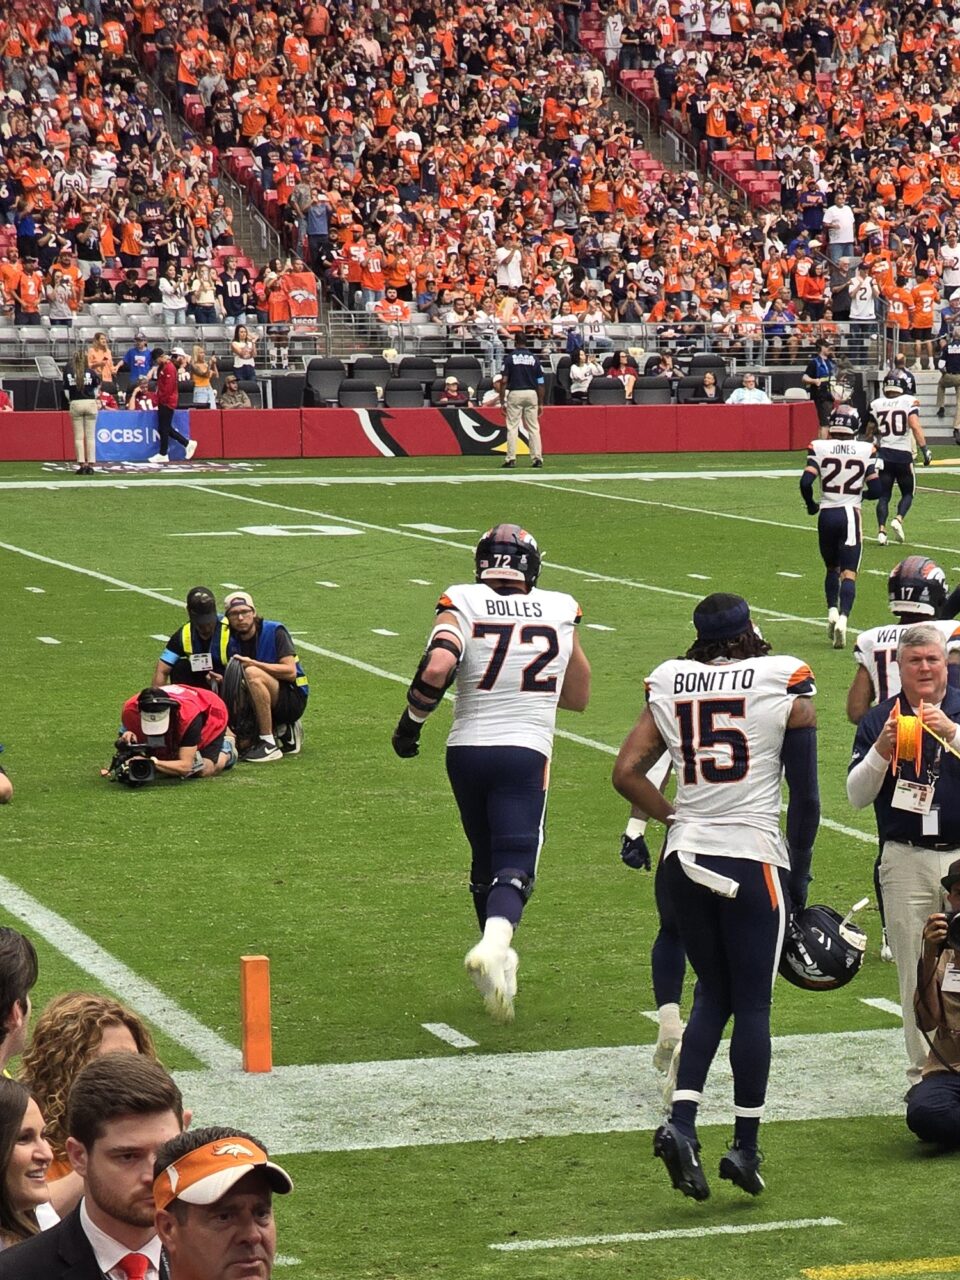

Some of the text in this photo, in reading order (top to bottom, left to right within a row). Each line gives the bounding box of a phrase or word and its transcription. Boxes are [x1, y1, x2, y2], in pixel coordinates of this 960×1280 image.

[612, 22, 619, 32] 2
[660, 23, 670, 36] 10
[85, 30, 99, 46] 12
[109, 31, 120, 43] 15
[939, 53, 947, 66] 2
[49, 235, 57, 248] 2
[368, 259, 382, 273] 10
[951, 256, 959, 271] 2
[27, 281, 35, 295] 2
[226, 281, 241, 297] 10
[859, 287, 867, 301] 2
[922, 296, 932, 312] 2
[876, 410, 907, 437] 30
[111, 429, 143, 443] CBS
[830, 444, 857, 455] JONES
[821, 457, 865, 495] 22
[493, 554, 512, 569] 72
[900, 587, 913, 600] 17
[485, 599, 543, 618] BOLLES
[471, 621, 560, 693] 72
[673, 668, 755, 695] BONITTO
[674, 697, 750, 785] 15
